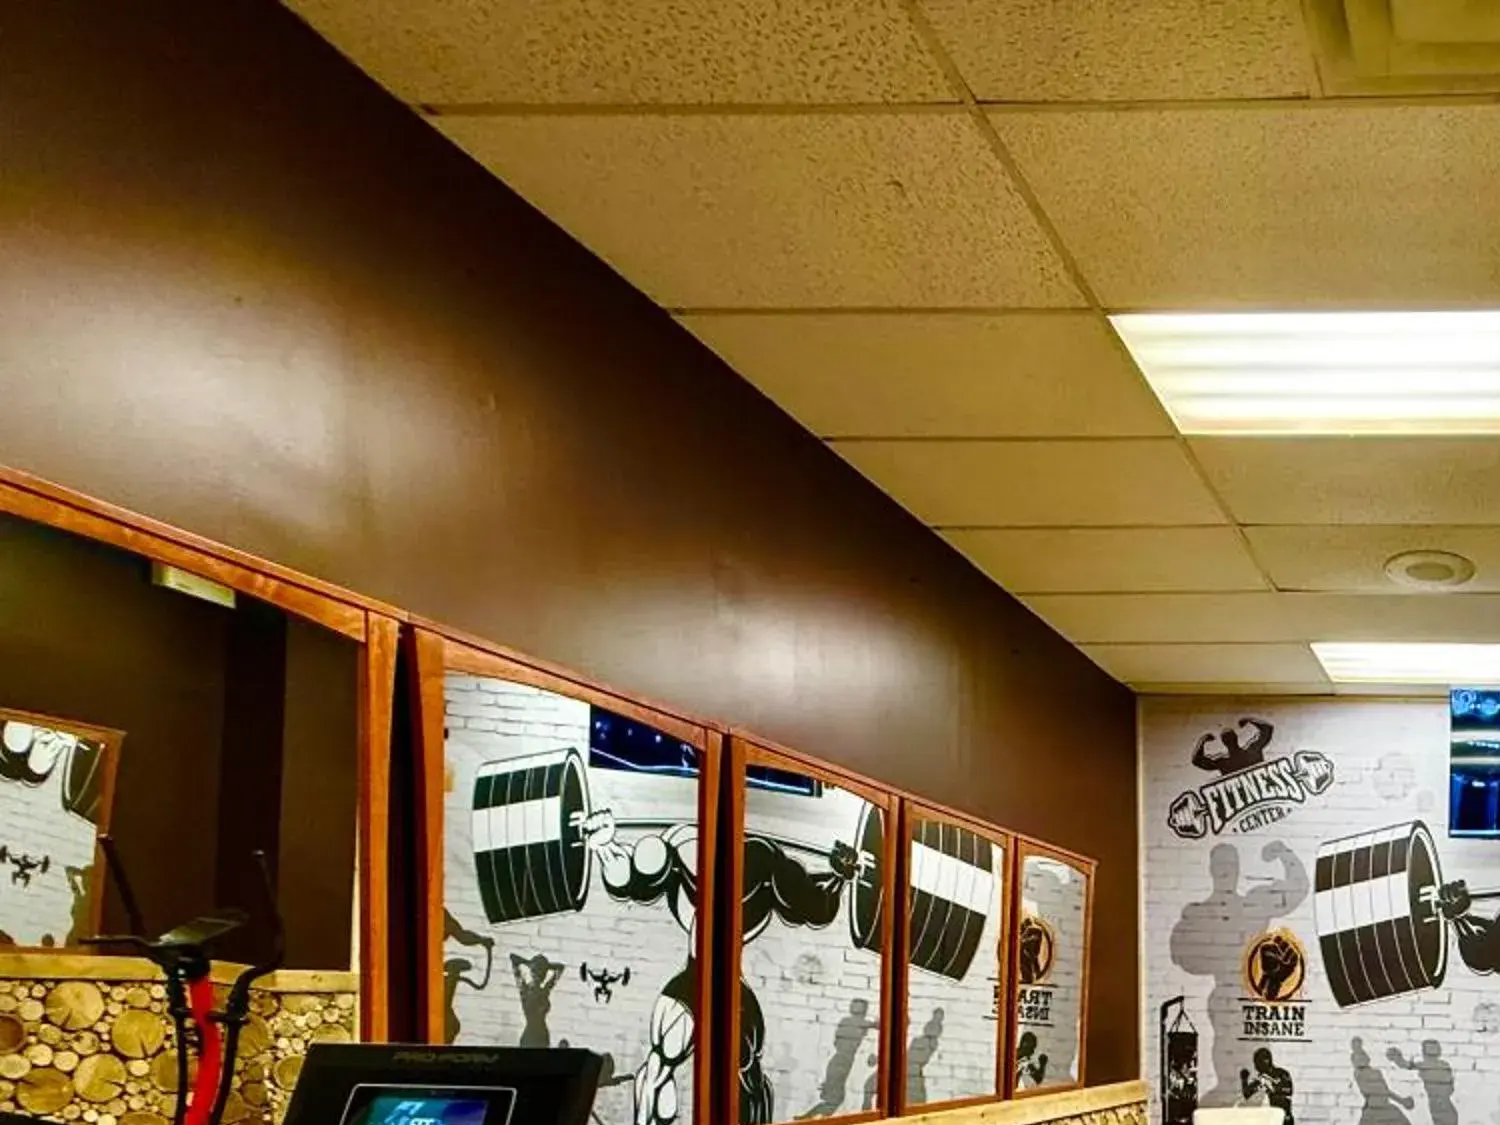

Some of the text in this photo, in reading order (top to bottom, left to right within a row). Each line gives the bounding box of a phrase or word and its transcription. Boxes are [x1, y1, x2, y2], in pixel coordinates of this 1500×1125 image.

[1201, 760, 1303, 832] FITNESS
[1239, 806, 1285, 833] CENTER
[1241, 1005, 1306, 1021] TRAIN
[1242, 1021, 1305, 1037] INSANE
